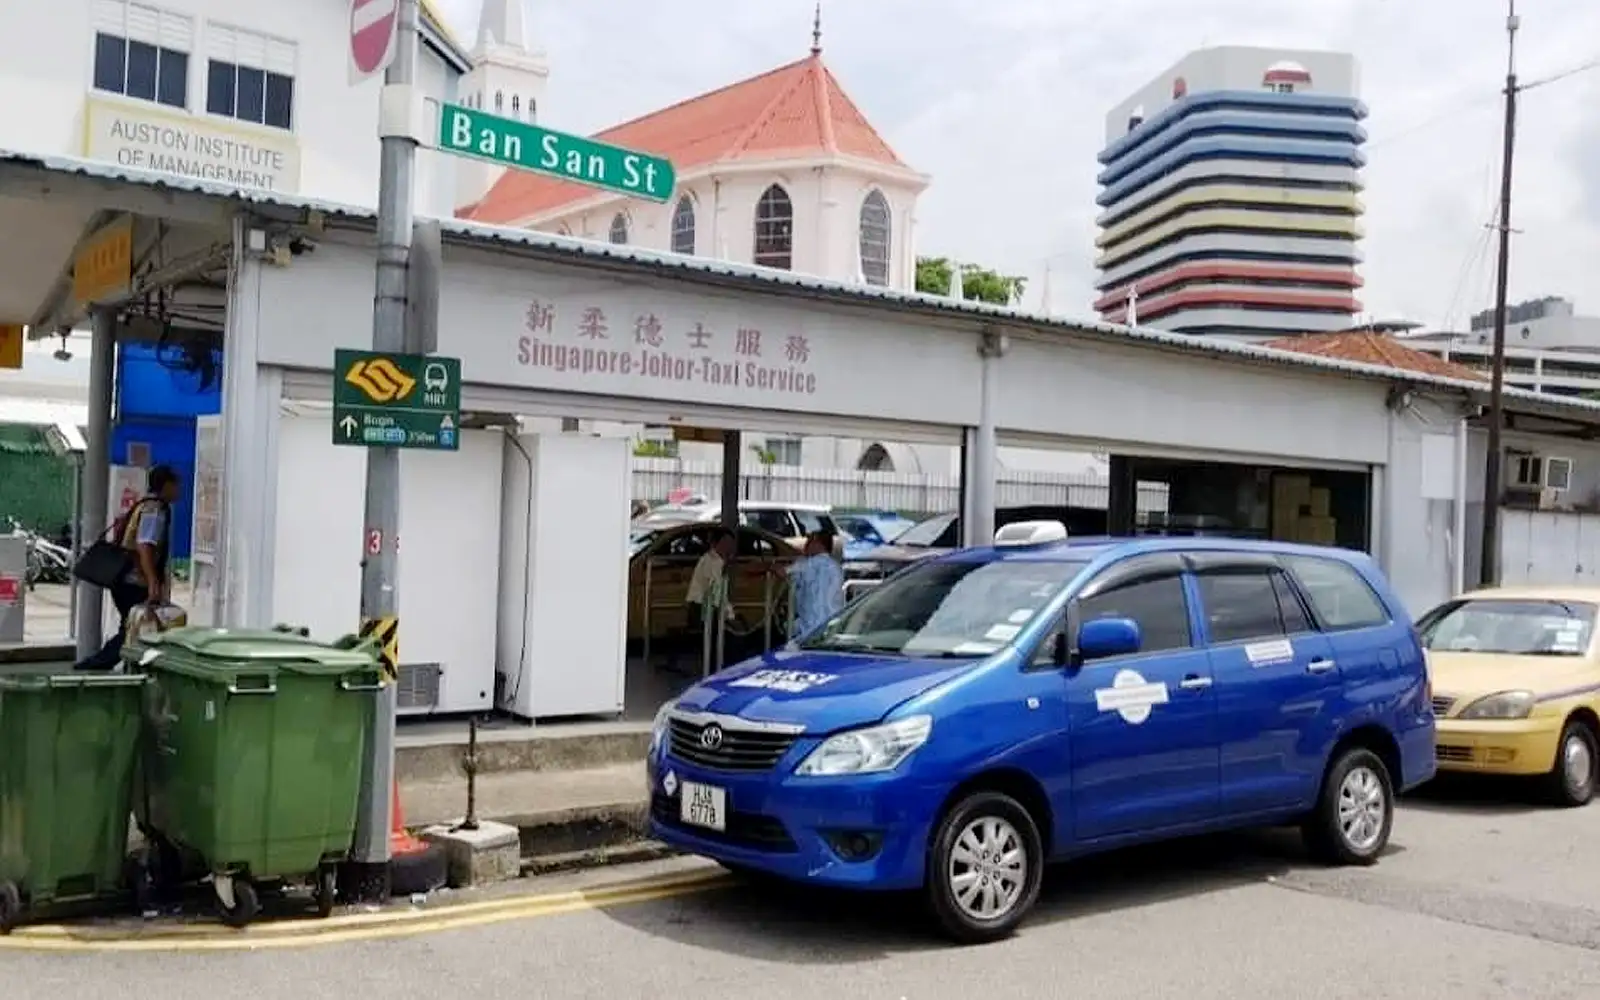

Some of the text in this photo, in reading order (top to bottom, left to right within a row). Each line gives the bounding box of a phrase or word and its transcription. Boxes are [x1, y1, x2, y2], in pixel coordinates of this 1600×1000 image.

[110, 119, 284, 170] AUSTON INSTITUTE
[117, 147, 274, 190] OF MANAGEMENT
[451, 112, 657, 193] Ban San St
[525, 299, 812, 364] 新柔德士服務
[517, 336, 816, 394] Singapore-Johor-Taxi Service
